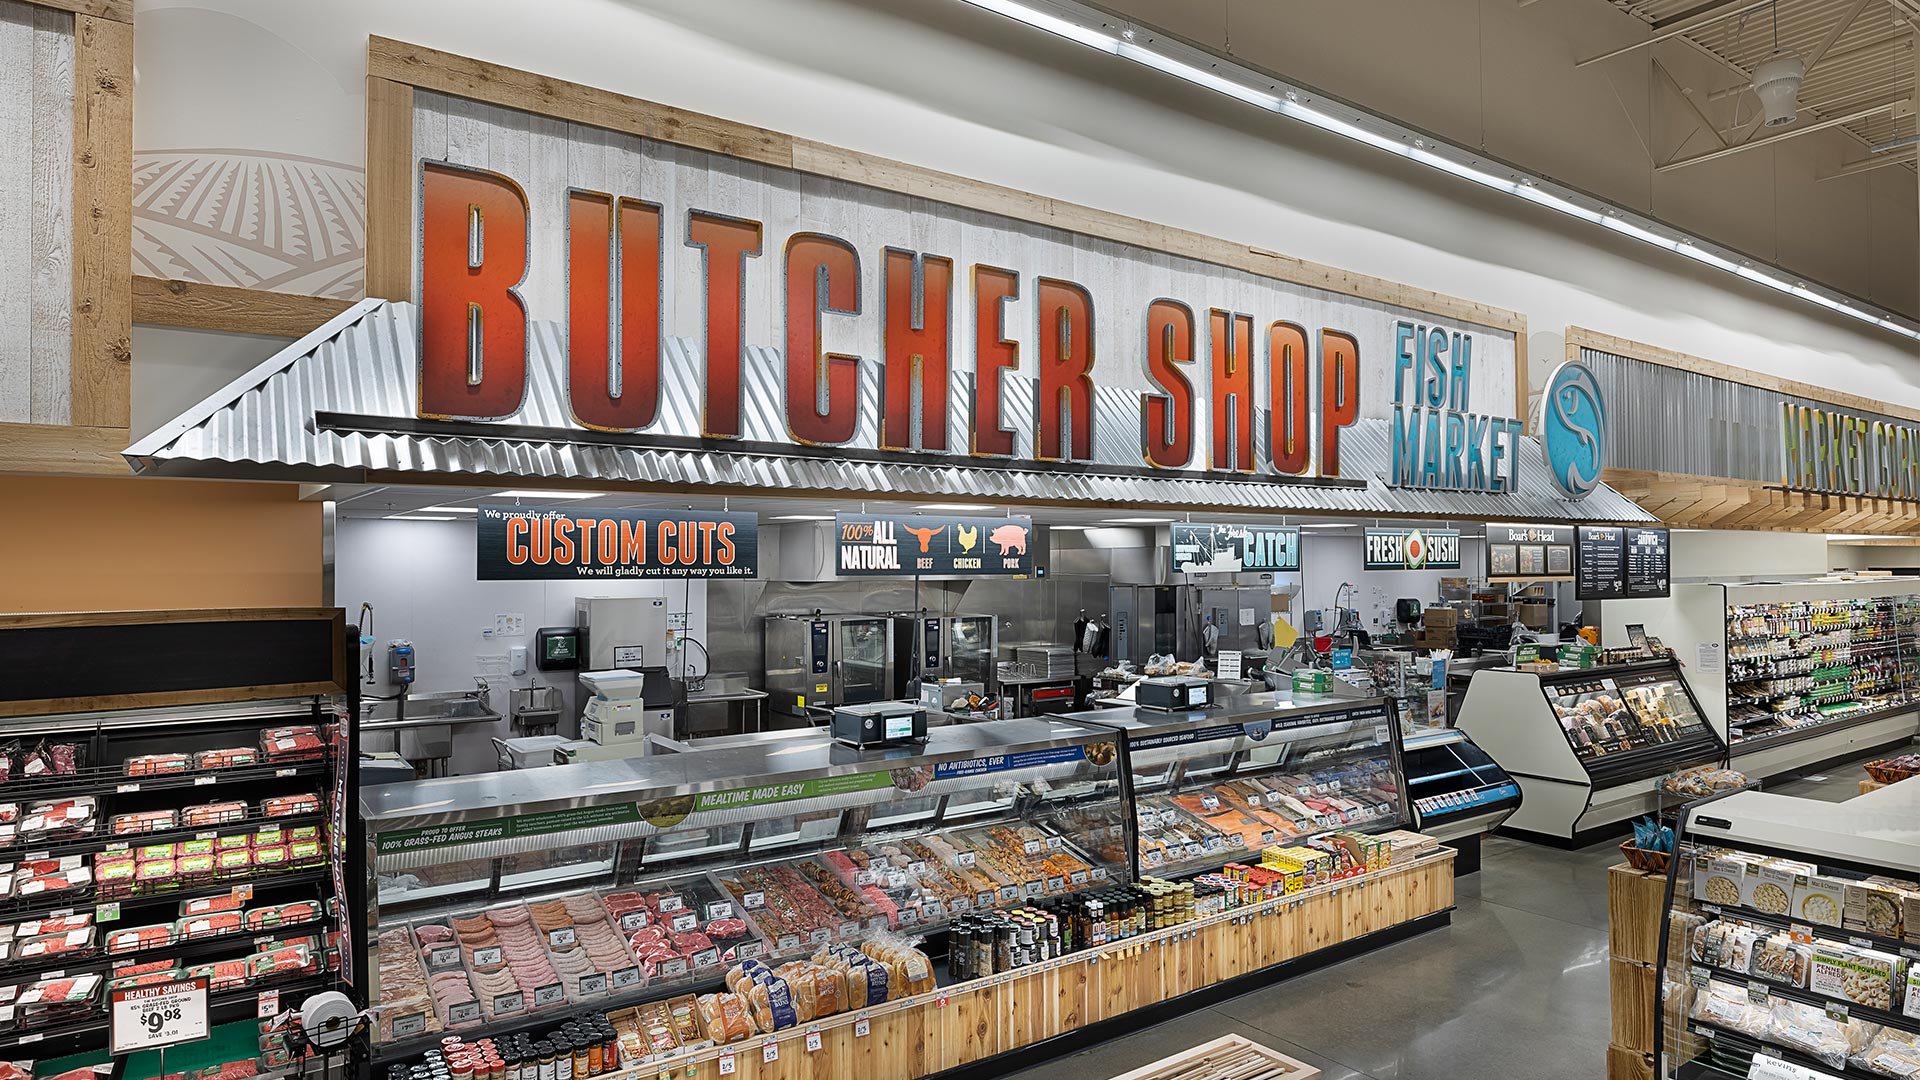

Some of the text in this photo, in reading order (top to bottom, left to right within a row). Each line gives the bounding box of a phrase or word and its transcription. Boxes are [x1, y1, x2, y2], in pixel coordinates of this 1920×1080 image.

[416, 157, 1361, 479] BUTCHER SHOP
[1393, 320, 1472, 413] FISH
[1390, 404, 1524, 493] MARKET
[1778, 401, 1869, 495] MARKET
[484, 509, 567, 521] We proudly offer
[506, 518, 736, 566] CUSTOM CUTS
[842, 520, 897, 544] 100% ALL
[1216, 524, 1249, 541] The Fresh
[1508, 528, 1554, 542] Boar's Head
[841, 545, 900, 570] NATURAL
[1243, 532, 1297, 567] CATCH
[1366, 536, 1460, 562] FRESH SUSHI
[577, 566, 593, 575] We
[596, 566, 613, 575] will
[615, 566, 644, 577] gladly
[663, 567, 670, 575] it
[671, 569, 688, 577] any
[689, 569, 708, 577] way
[709, 568, 725, 577] you
[726, 566, 742, 575] like
[744, 567, 753, 575] it.
[916, 558, 1020, 569] BEEF CHICKEN PORK
[938, 763, 947, 771] NO
[949, 759, 987, 770] ANTIBIOTICS,
[989, 756, 1004, 765] EVER
[701, 783, 804, 807] MEALTIME MADE EASY
[382, 828, 502, 849] 100% GRASS-FED ANGUS STEAKS
[334, 778, 349, 943] MEALTIME MADE EASY
[1817, 956, 1886, 977] SIMPLY PLANT POWERED
[1817, 964, 1840, 972] PENNE
[1817, 969, 1845, 978] ALFREDO
[125, 982, 196, 1000] HEALTHY SAVINGS
[1766, 1058, 1797, 1073] kevins
